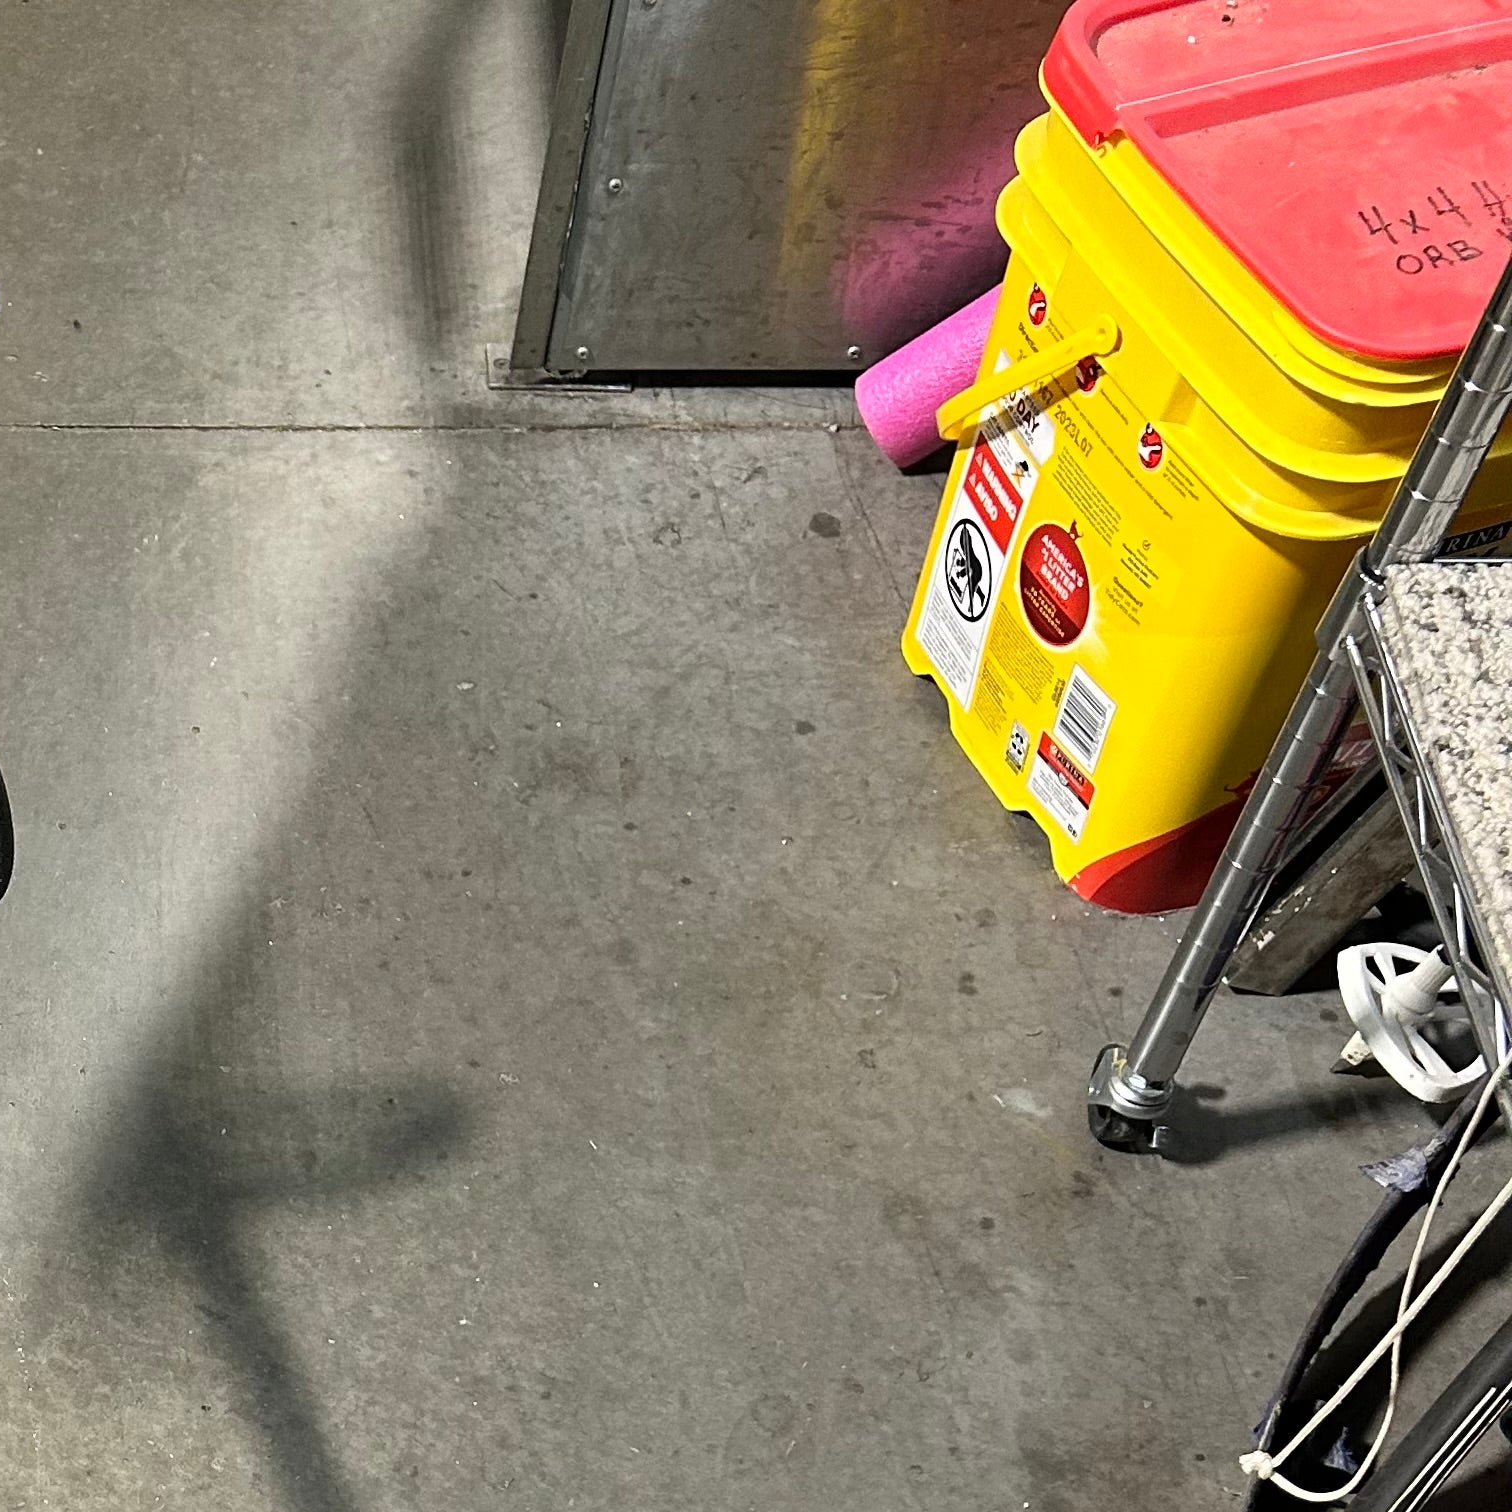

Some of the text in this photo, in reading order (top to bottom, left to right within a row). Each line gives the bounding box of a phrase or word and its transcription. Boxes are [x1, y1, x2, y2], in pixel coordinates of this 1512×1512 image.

[1396, 240, 1484, 275] ORB
[1017, 398, 1040, 433] DAY
[975, 481, 999, 522] AVISO
[982, 458, 1017, 522] WARNING
[1446, 525, 1505, 553] RINA
[1041, 534, 1085, 588] AMERICA'S
[1048, 556, 1076, 593] LITTER
[1040, 563, 1069, 601] BRAND
